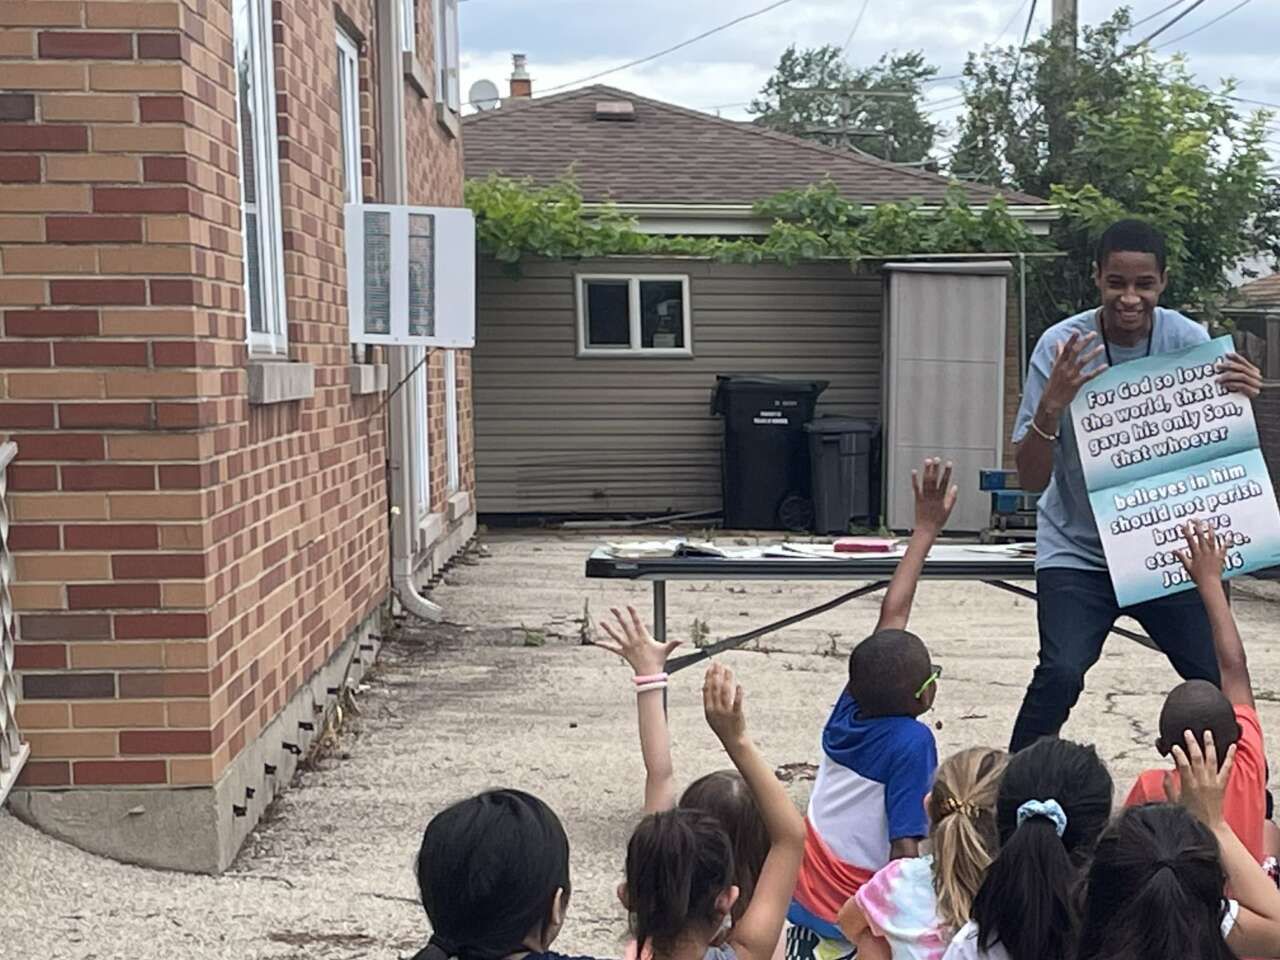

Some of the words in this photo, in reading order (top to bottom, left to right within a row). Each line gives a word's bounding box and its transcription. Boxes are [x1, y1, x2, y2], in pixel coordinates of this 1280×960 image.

[1081, 414, 1113, 432] the
[1114, 397, 1171, 423] world,
[1173, 382, 1214, 407] that
[1086, 388, 1115, 409] For
[1117, 377, 1151, 399] God
[1155, 374, 1175, 390] so
[1088, 432, 1130, 456] gave
[1132, 421, 1159, 442] his
[1161, 409, 1201, 431] only
[1202, 401, 1243, 421] Son,
[1111, 445, 1152, 468] that
[1152, 426, 1228, 457] whoever
[1110, 504, 1169, 535] should
[1173, 494, 1205, 518] not
[1207, 480, 1263, 512] perish
[1113, 478, 1186, 511] believes
[1190, 470, 1209, 491] in
[1211, 463, 1246, 486] him
[1153, 524, 1184, 545] but
[1145, 547, 1194, 570] etern
[1162, 568, 1192, 589] Joh
[1223, 551, 1244, 571] 16
